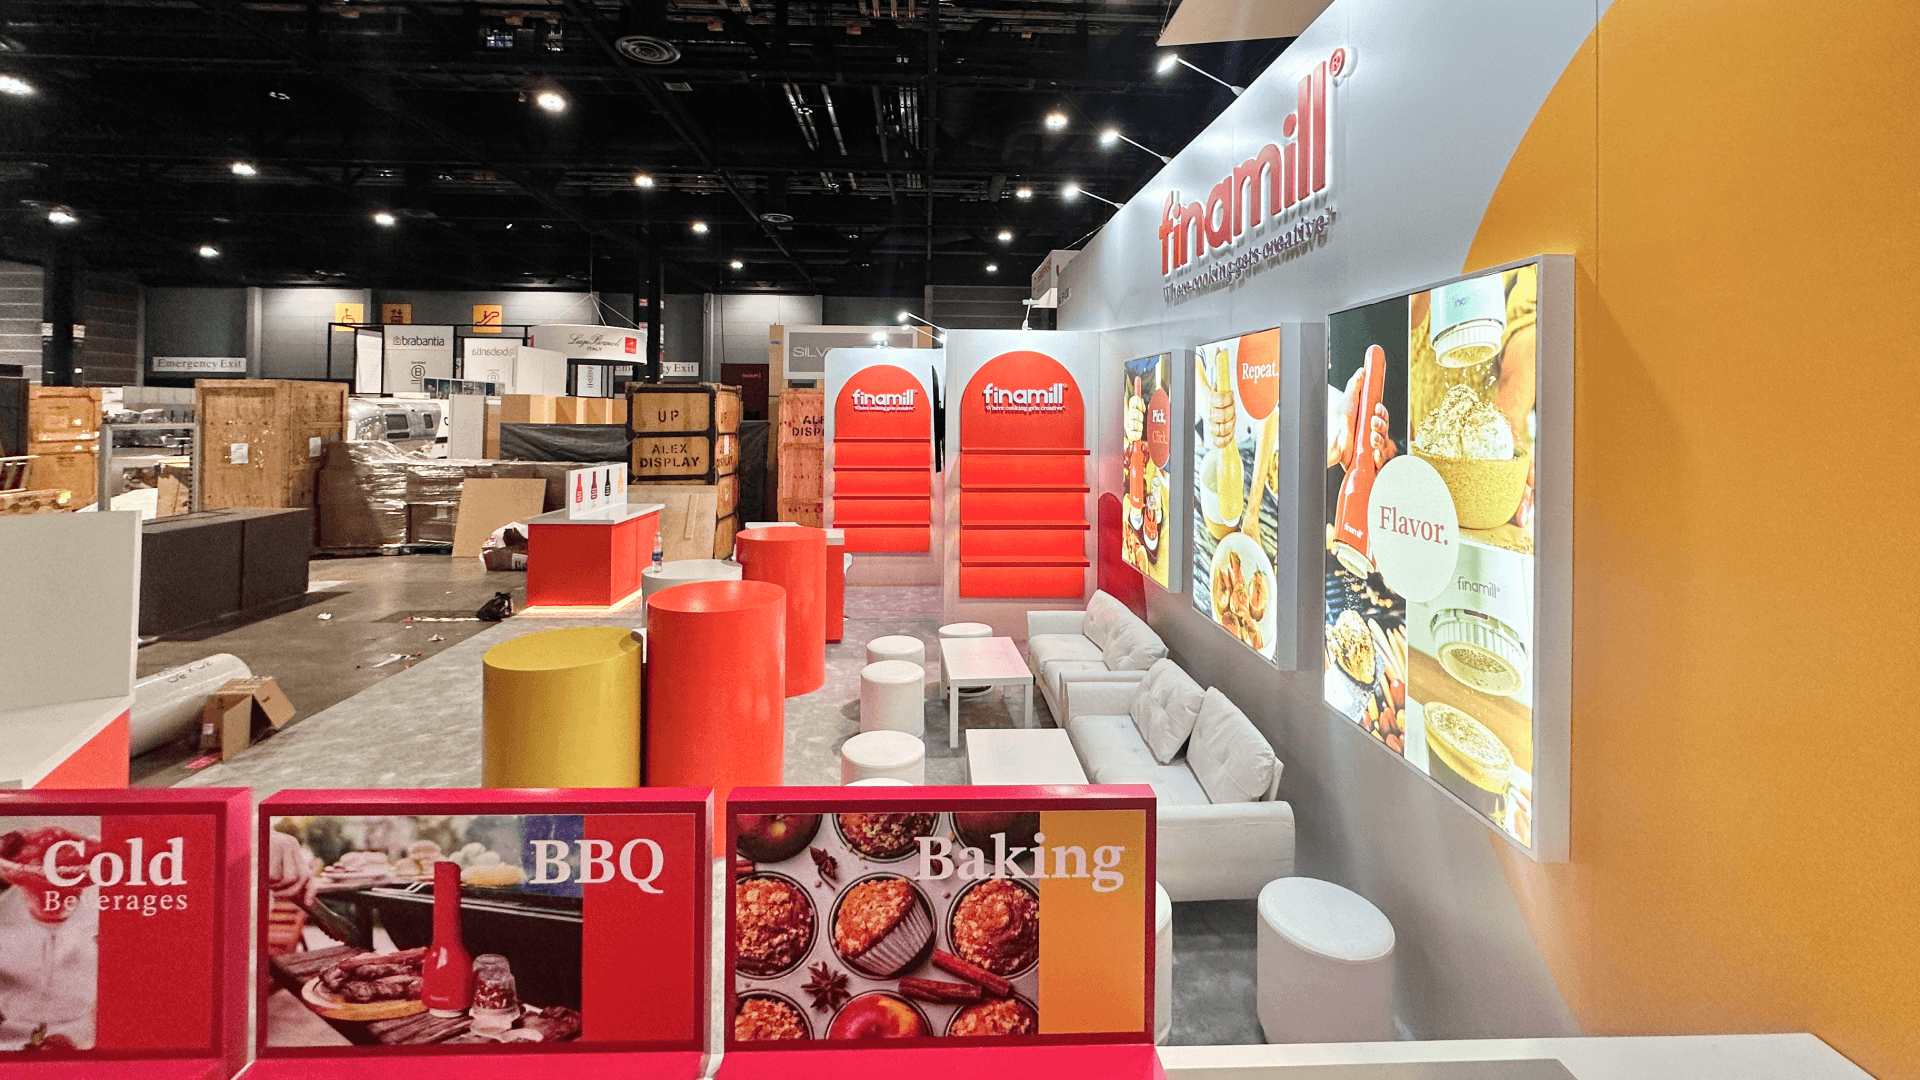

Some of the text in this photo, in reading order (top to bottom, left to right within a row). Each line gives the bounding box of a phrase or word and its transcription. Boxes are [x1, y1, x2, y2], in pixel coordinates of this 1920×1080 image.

[1163, 281, 1190, 302] Where
[1192, 262, 1232, 290] cooking
[1235, 247, 1261, 279] gets
[402, 336, 445, 346] brabantia
[157, 359, 241, 370] Emergency Exit
[674, 363, 695, 372] Exit
[1242, 360, 1279, 384] Repeat.
[658, 410, 679, 422] UP
[652, 444, 687, 454] ALEX
[640, 456, 699, 468] DISPLAY
[1379, 505, 1448, 545] Flavor.
[43, 837, 187, 887] Cold
[530, 838, 665, 894] BBQ
[914, 832, 1126, 893] Baking
